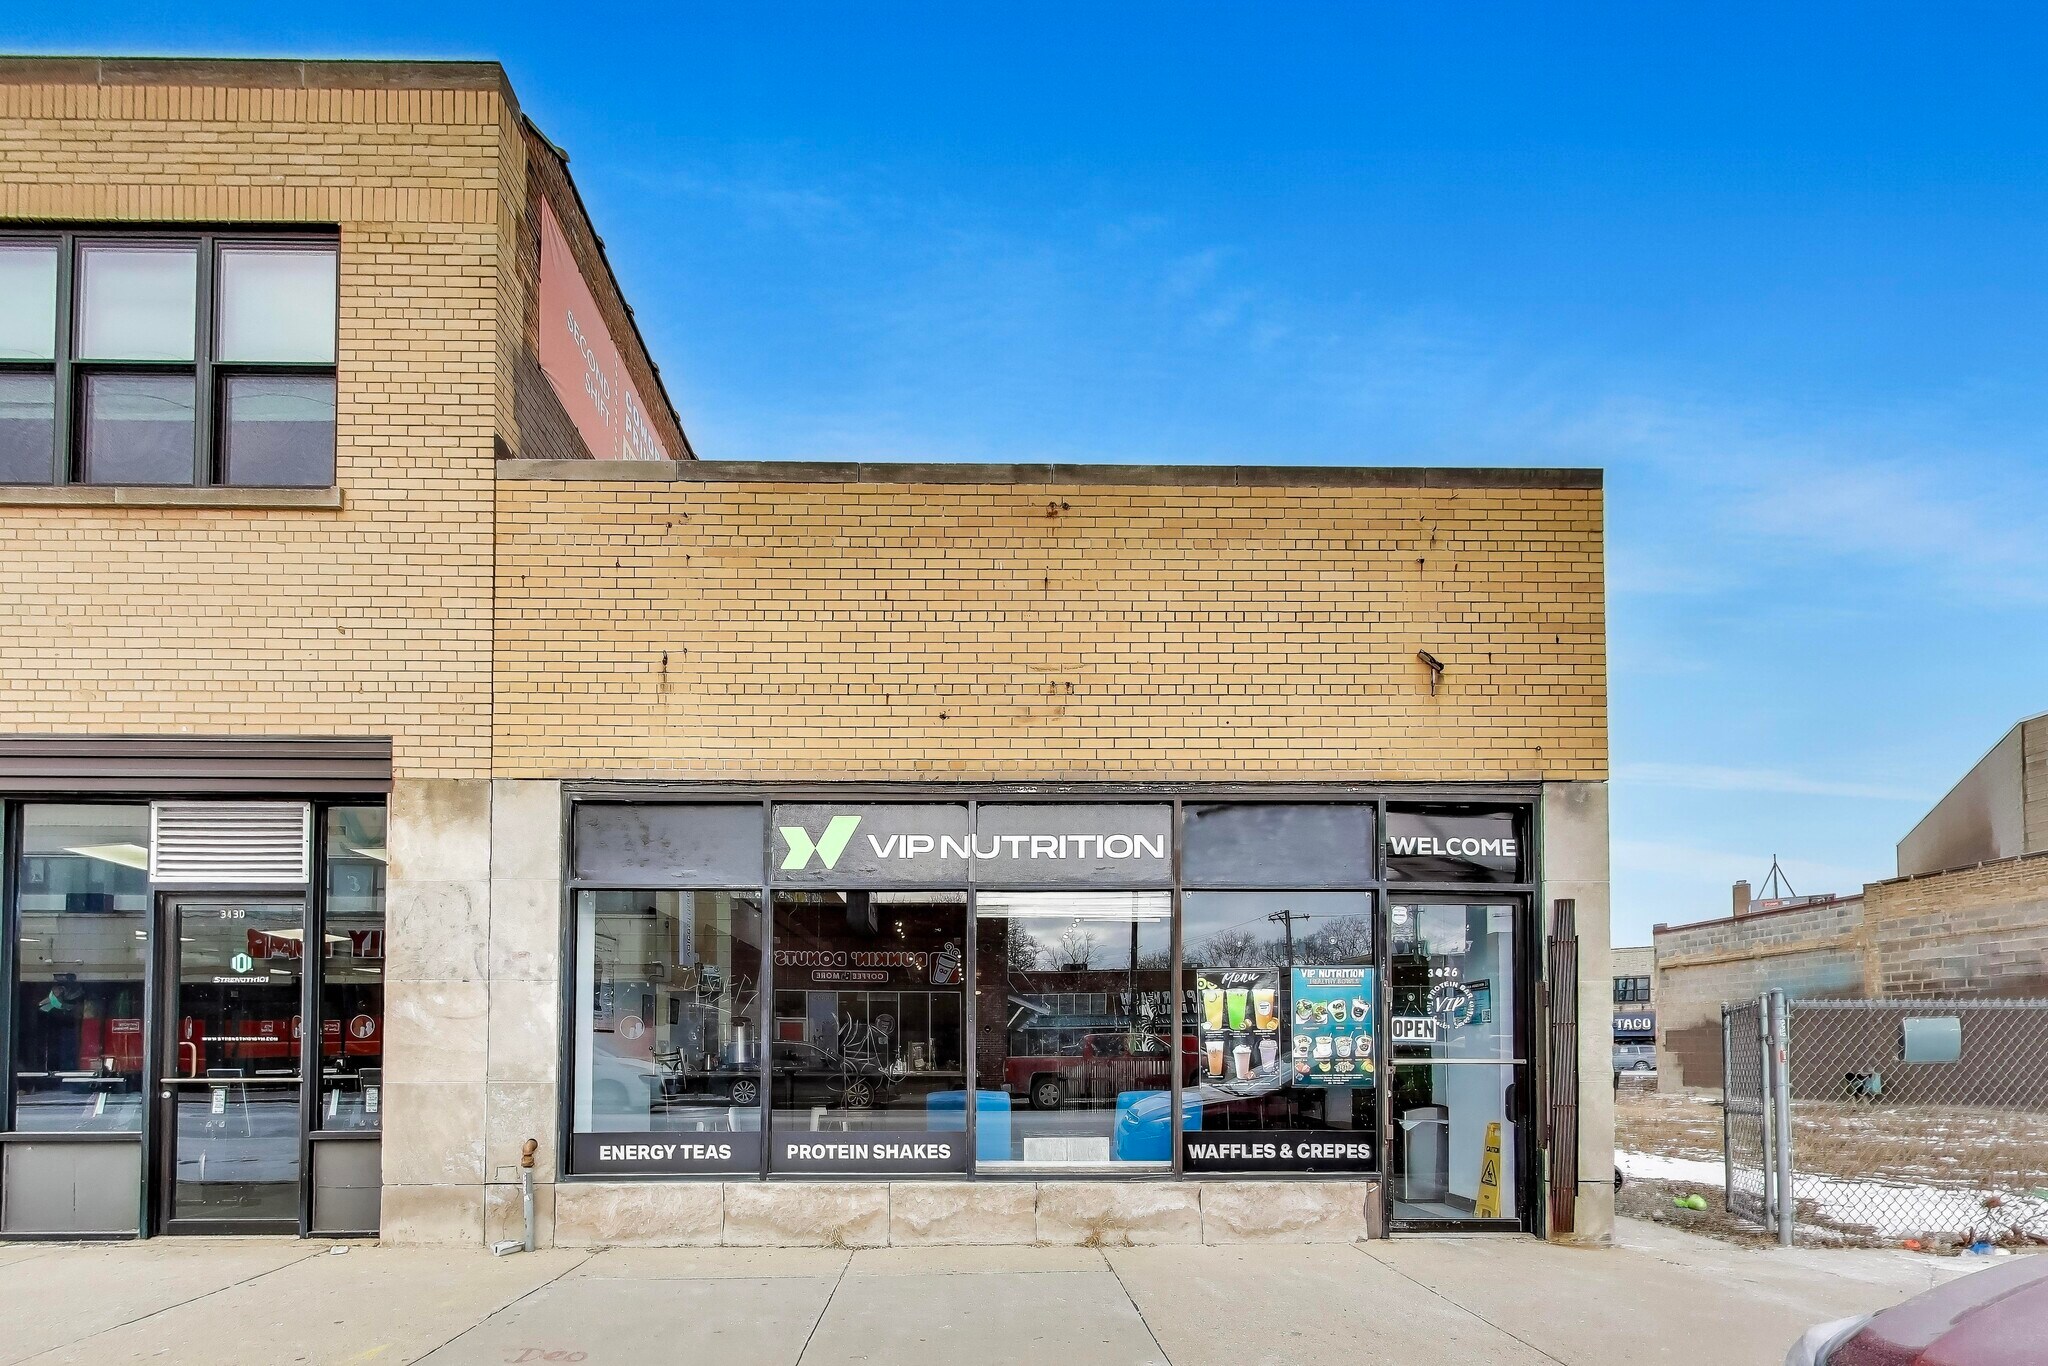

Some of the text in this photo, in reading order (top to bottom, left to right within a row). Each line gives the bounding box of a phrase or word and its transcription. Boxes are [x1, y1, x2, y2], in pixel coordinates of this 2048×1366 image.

[566, 310, 610, 399] SECOND
[584, 372, 611, 427] SHIFT
[867, 833, 1165, 860] VIP NUTRITION
[1390, 836, 1517, 857] WELCOME
[219, 909, 246, 919] 3430
[1221, 972, 1260, 988] Menu
[1301, 968, 1365, 978] VIP NUTRITION
[1427, 981, 1459, 1000] PROTEIN
[1459, 984, 1474, 999] BAR
[1435, 996, 1465, 1013] VIP
[1392, 1019, 1435, 1038] OPEN
[1615, 1018, 1651, 1030] TACO
[599, 1144, 732, 1161] ENERGY TEAS
[787, 1144, 951, 1160] PROTEIN SHAKES
[1188, 1143, 1370, 1160] WAFFLES & CREPES
